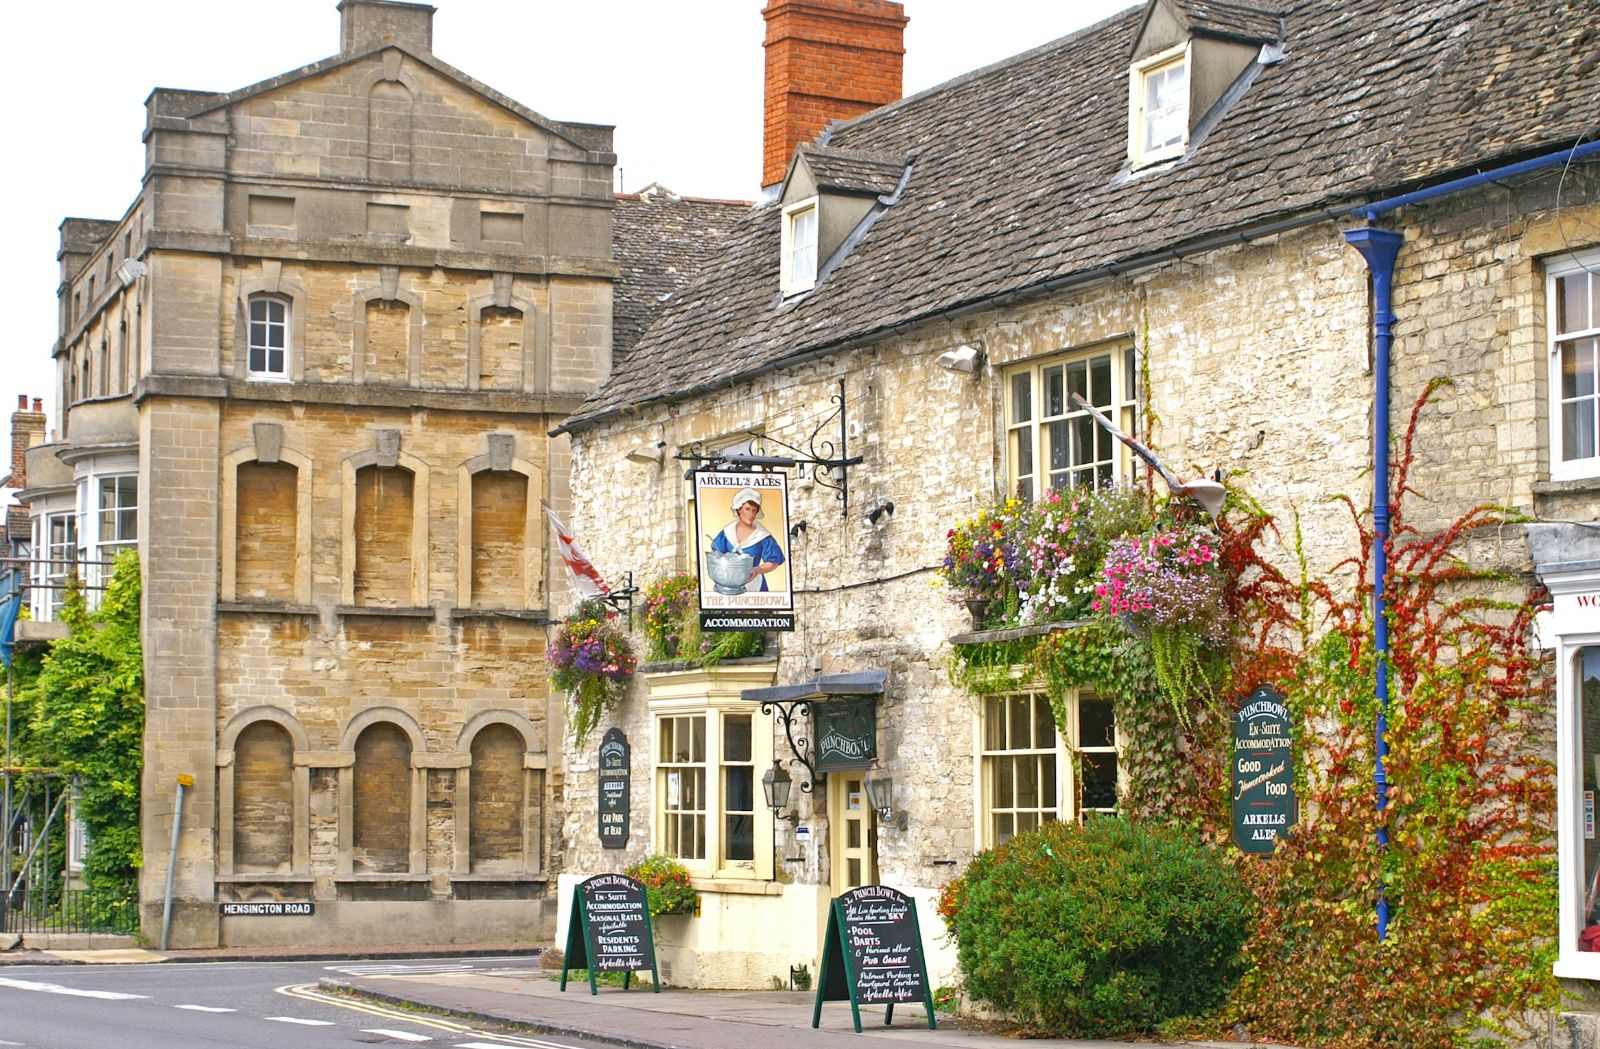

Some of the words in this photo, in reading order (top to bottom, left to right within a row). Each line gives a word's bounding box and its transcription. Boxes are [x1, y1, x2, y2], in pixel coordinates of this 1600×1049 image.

[700, 477, 750, 486] ARKELL'S
[754, 478, 781, 486] ALES
[705, 596, 724, 606] THE
[728, 596, 788, 606] PUNCHBOWL
[704, 618, 790, 628] ACCOMMODATION
[1238, 701, 1288, 722] PUNCHBOWL
[1238, 757, 1261, 773] GOOD
[603, 782, 624, 790] ARKELLS
[1265, 781, 1287, 796] FOOD
[602, 813, 611, 823] CAR
[612, 813, 624, 823] PARK
[1242, 814, 1286, 825] ARKELLS
[610, 825, 622, 835] REAR
[590, 876, 612, 889] PUNCH
[612, 875, 630, 888] BOWL
[853, 886, 875, 901] PUNCH
[876, 885, 895, 900] BOWL
[224, 904, 282, 914] HENSINGTON
[285, 904, 310, 913] ROAD
[586, 900, 642, 910] ACCOMMODATION
[588, 912, 620, 922] SEASONAL
[621, 913, 643, 921] RATES
[851, 926, 874, 935] POOL
[597, 936, 640, 944] RESIDENTS
[853, 936, 880, 946] DARTS
[602, 945, 637, 953] PARKING
[892, 943, 911, 953] other
[862, 956, 878, 965] PUB
[882, 955, 907, 964] GAMES
[860, 971, 885, 980] Patrons
[886, 970, 912, 980] Parking
[857, 980, 890, 989] Courtyard
[893, 978, 920, 986] Garden
[863, 988, 893, 1002] Arkells
[894, 986, 912, 1001] Ales
